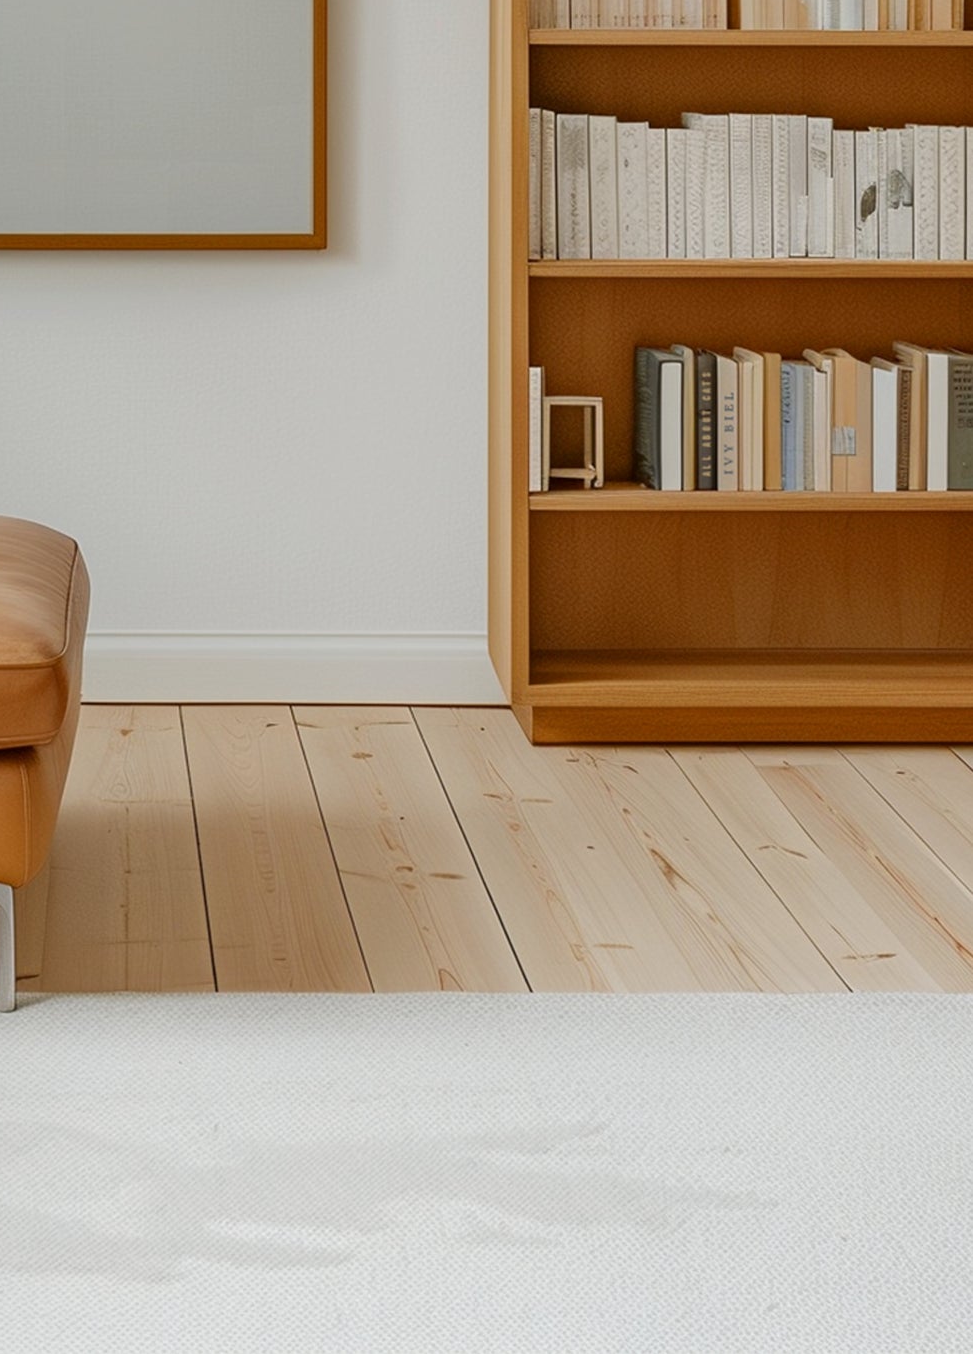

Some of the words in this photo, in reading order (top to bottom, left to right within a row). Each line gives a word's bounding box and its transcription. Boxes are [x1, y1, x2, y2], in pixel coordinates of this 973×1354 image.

[702, 372, 712, 401] CATS
[724, 392, 735, 432] BIEL
[702, 410, 712, 448] ABOUT
[702, 455, 712, 478] ALL
[724, 445, 735, 475] IVY
